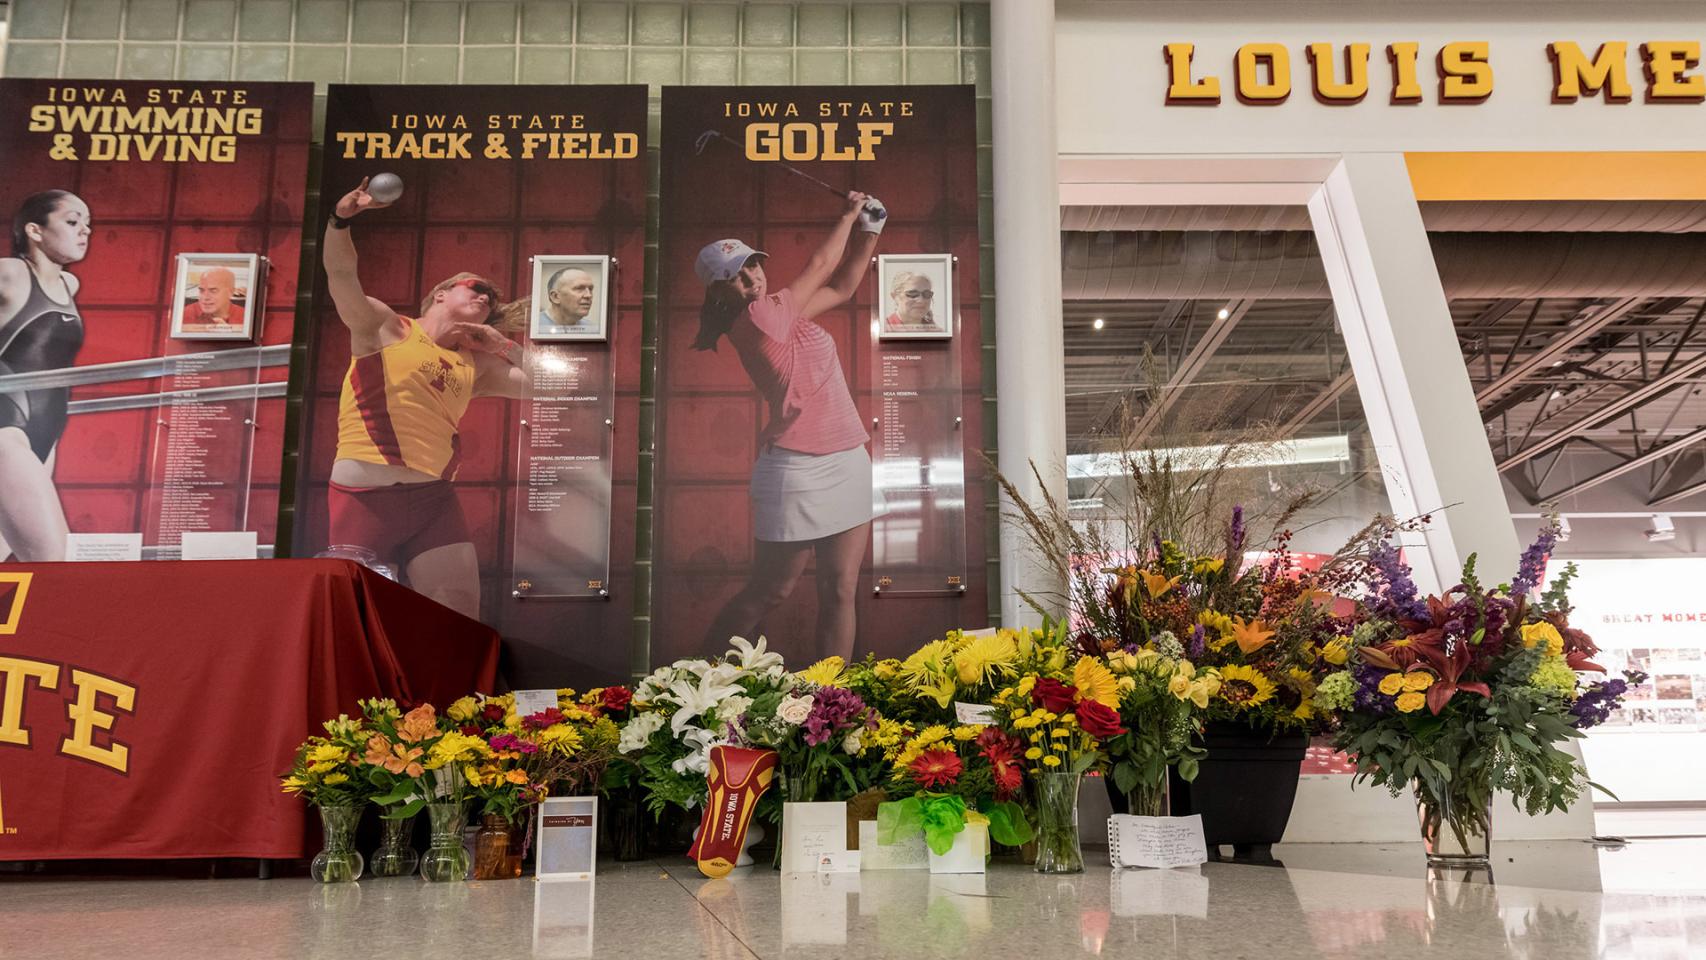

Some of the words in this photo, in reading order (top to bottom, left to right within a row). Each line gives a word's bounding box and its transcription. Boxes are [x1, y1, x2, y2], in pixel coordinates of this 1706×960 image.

[1164, 41, 1494, 106] LOUIS
[48, 87, 127, 103] IOWA
[147, 89, 248, 105] STATE
[724, 103, 799, 117] IOWA
[819, 102, 914, 117] STATE
[28, 105, 263, 135] SWIMMING
[391, 115, 467, 129] IOWA
[488, 115, 585, 129] STATE
[49, 133, 79, 161] &
[88, 134, 237, 163] DIVING
[336, 132, 473, 159] TRACK
[483, 132, 512, 159] &
[521, 132, 639, 159] FIELD
[745, 122, 894, 161] GOLF
[728, 793, 739, 812] IOWA
